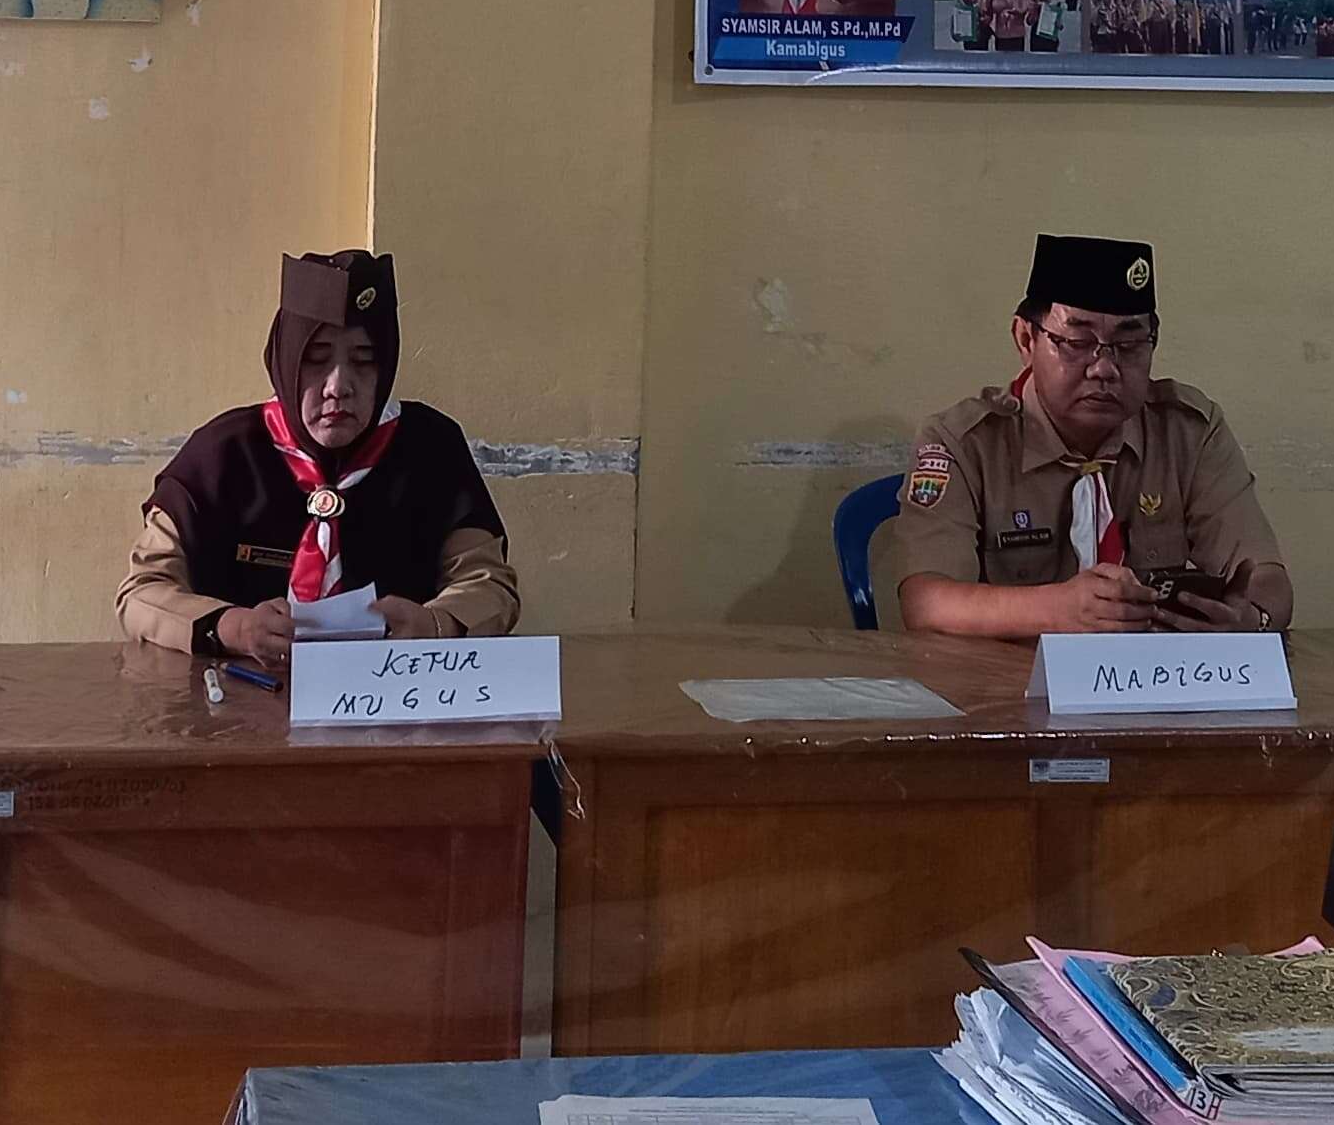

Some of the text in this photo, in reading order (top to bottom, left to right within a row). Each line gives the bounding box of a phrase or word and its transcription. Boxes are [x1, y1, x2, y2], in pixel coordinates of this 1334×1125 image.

[721, 18, 781, 35] SYAMSIR
[784, 20, 827, 38] ALAM,
[766, 39, 846, 60] Kamabigus
[372, 648, 482, 677] KETUA
